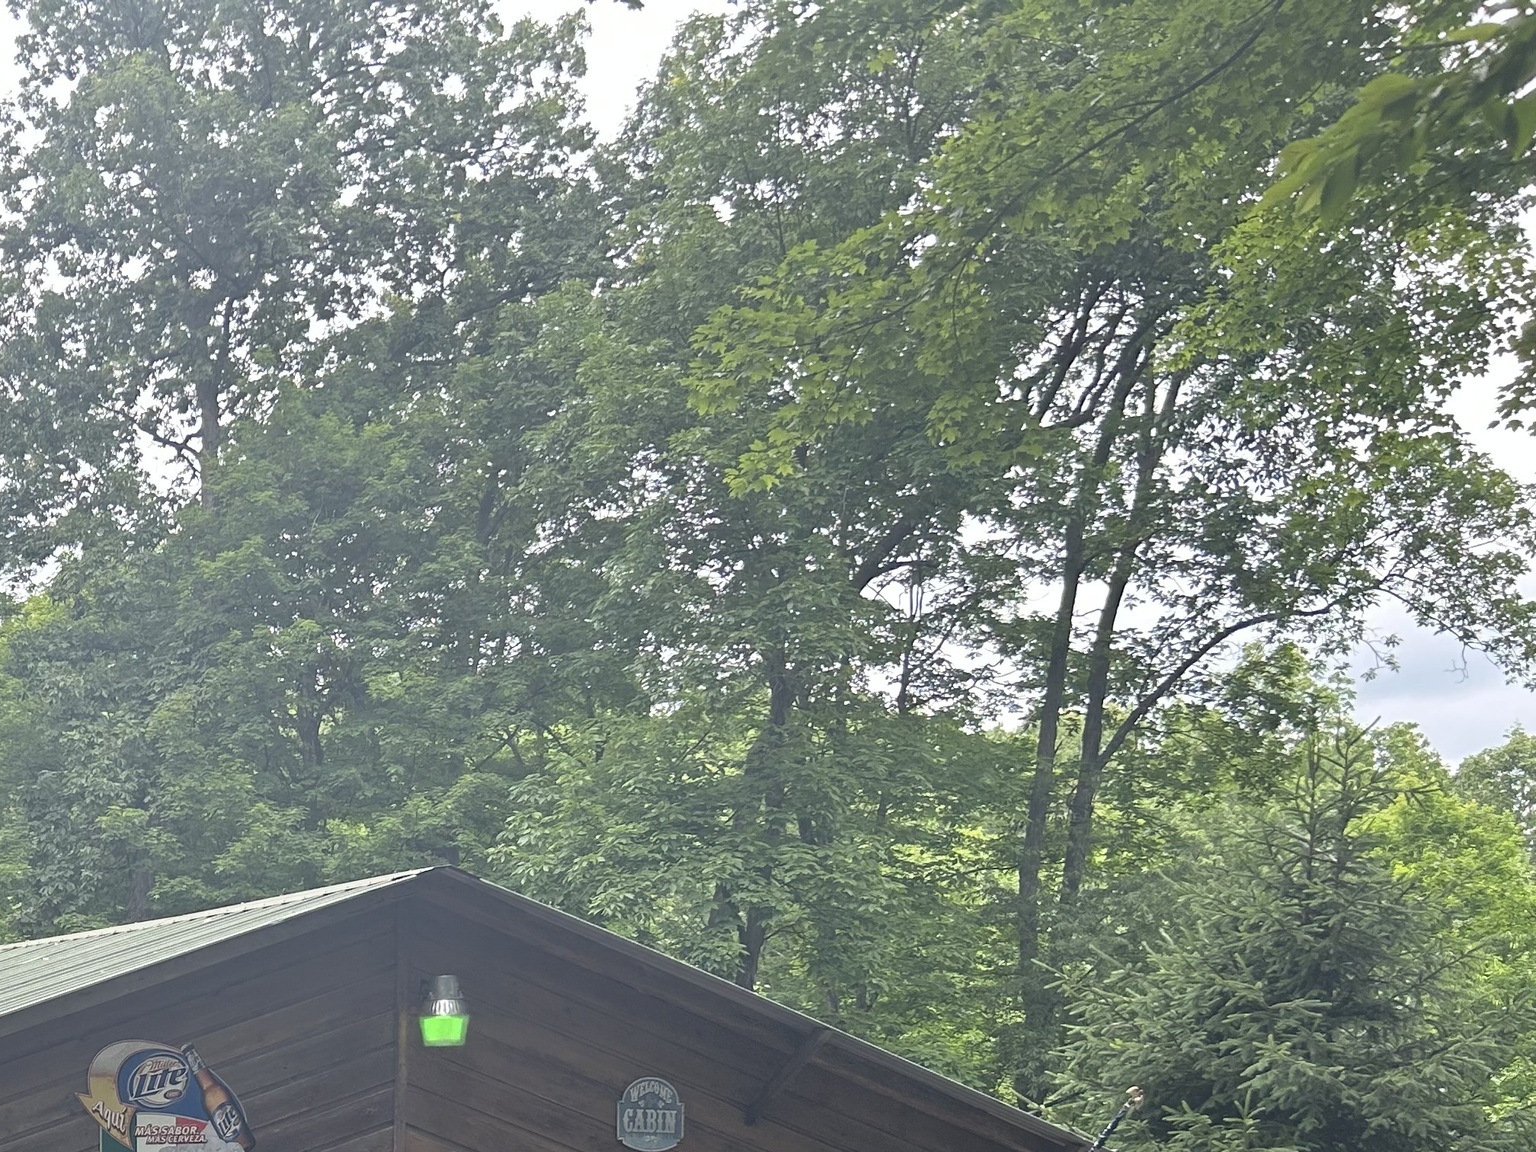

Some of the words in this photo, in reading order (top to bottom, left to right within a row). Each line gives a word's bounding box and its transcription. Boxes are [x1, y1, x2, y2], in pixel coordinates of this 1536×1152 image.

[139, 1060, 180, 1074] Miller
[133, 1068, 187, 1098] Lite
[630, 1081, 673, 1104] WELCOME
[92, 1101, 126, 1133] Aquí
[623, 1108, 677, 1134] CABIN
[135, 1124, 159, 1136] MÁS
[159, 1126, 200, 1136] SABOR.
